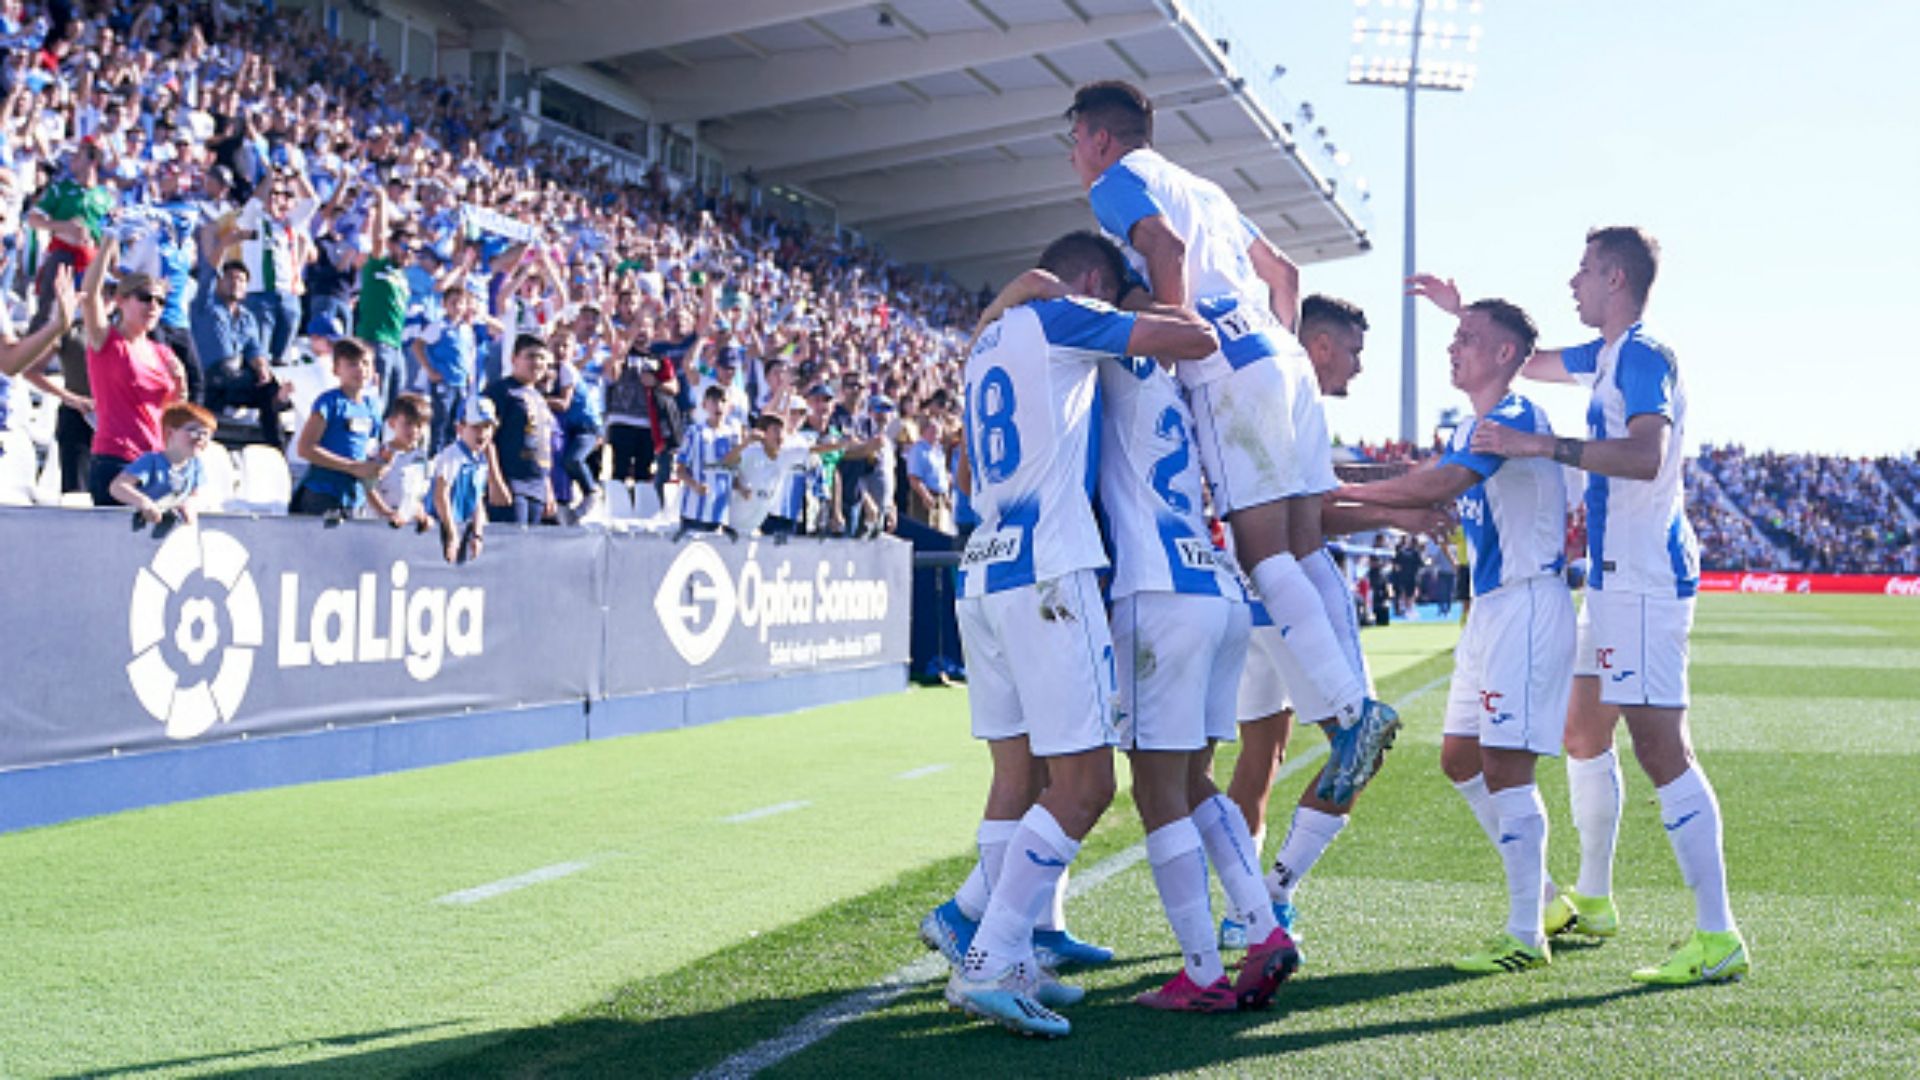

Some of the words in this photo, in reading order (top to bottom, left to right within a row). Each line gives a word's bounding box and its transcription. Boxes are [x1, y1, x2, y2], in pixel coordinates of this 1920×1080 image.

[278, 560, 485, 681] LaLiga
[739, 542, 812, 643] Óptica
[816, 560, 888, 624] Soriano
